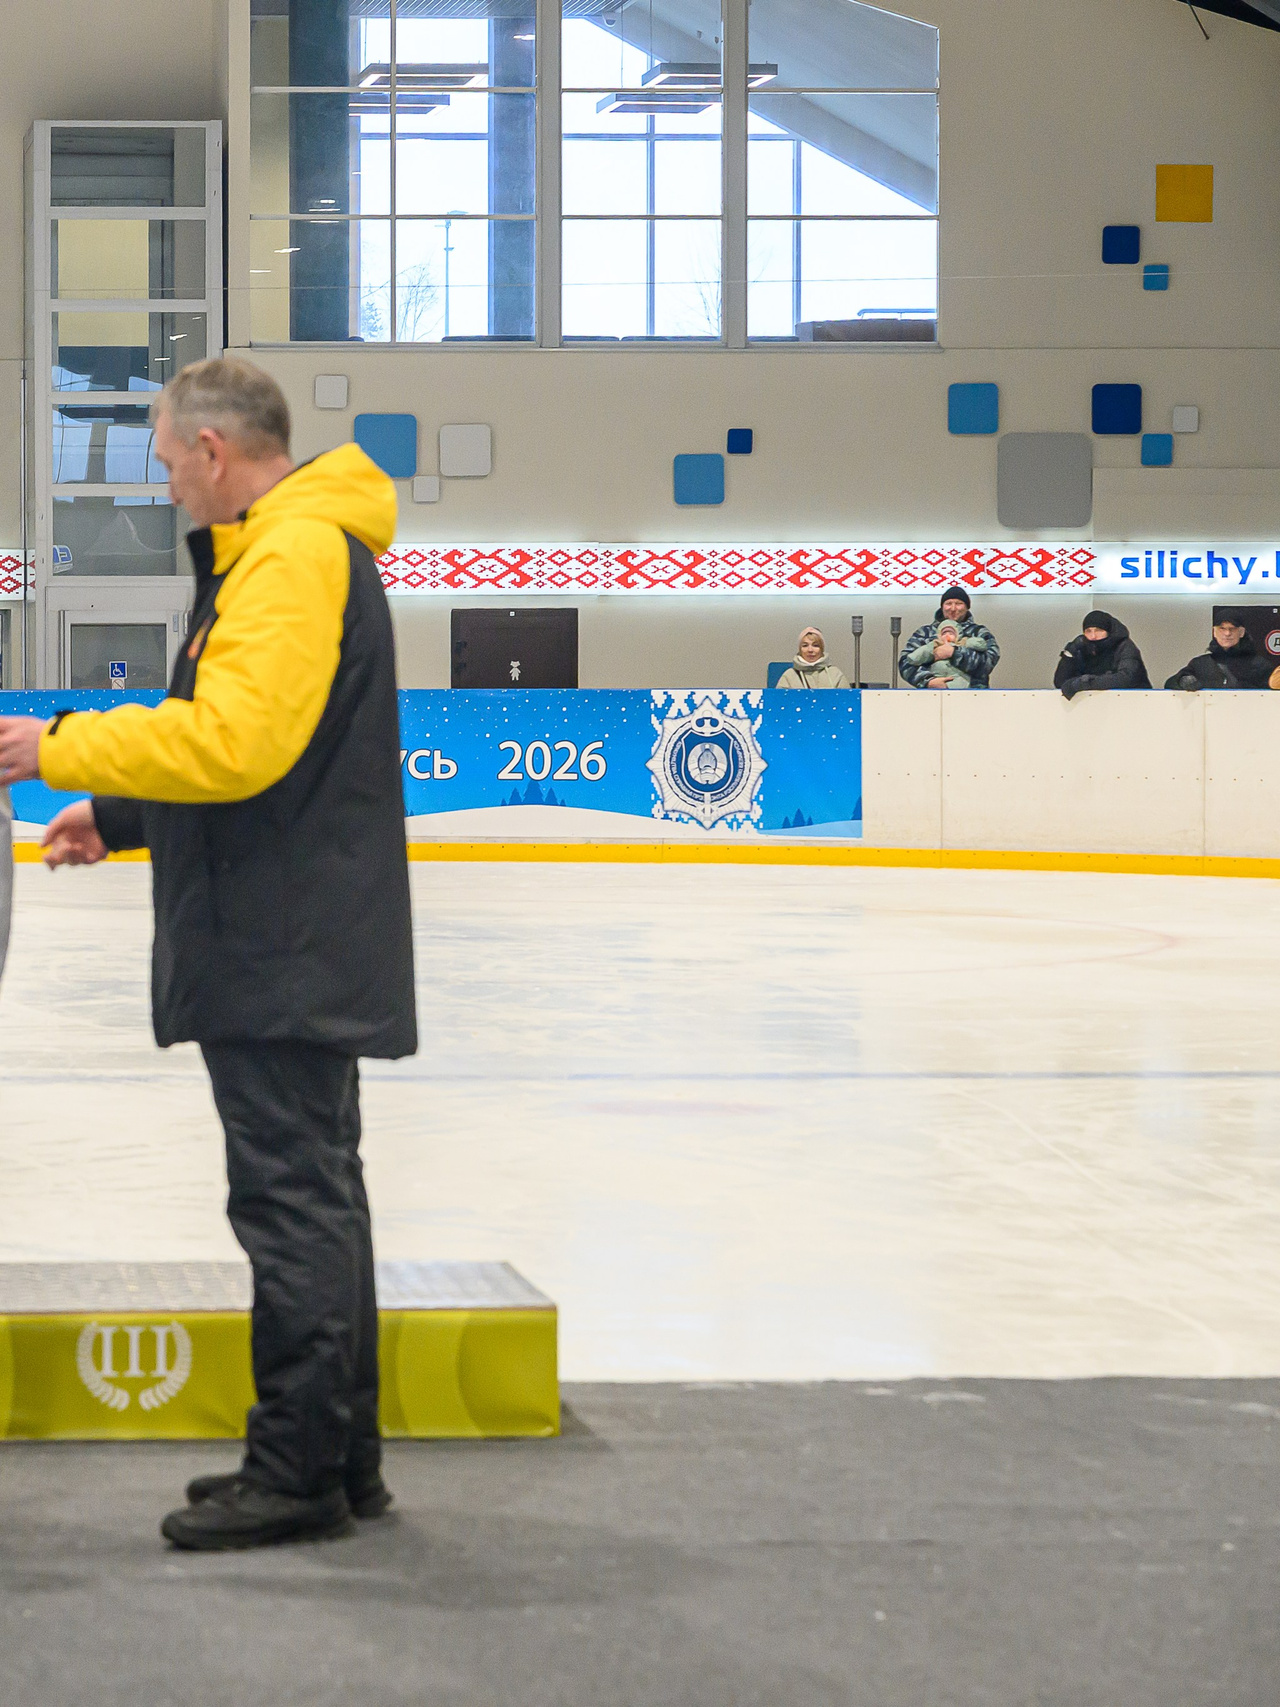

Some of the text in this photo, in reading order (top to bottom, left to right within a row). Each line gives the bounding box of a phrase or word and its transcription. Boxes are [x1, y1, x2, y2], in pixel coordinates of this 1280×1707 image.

[1120, 550, 1280, 585] silichy.
[496, 739, 608, 782] 2026
[98, 1325, 173, 1377] III
